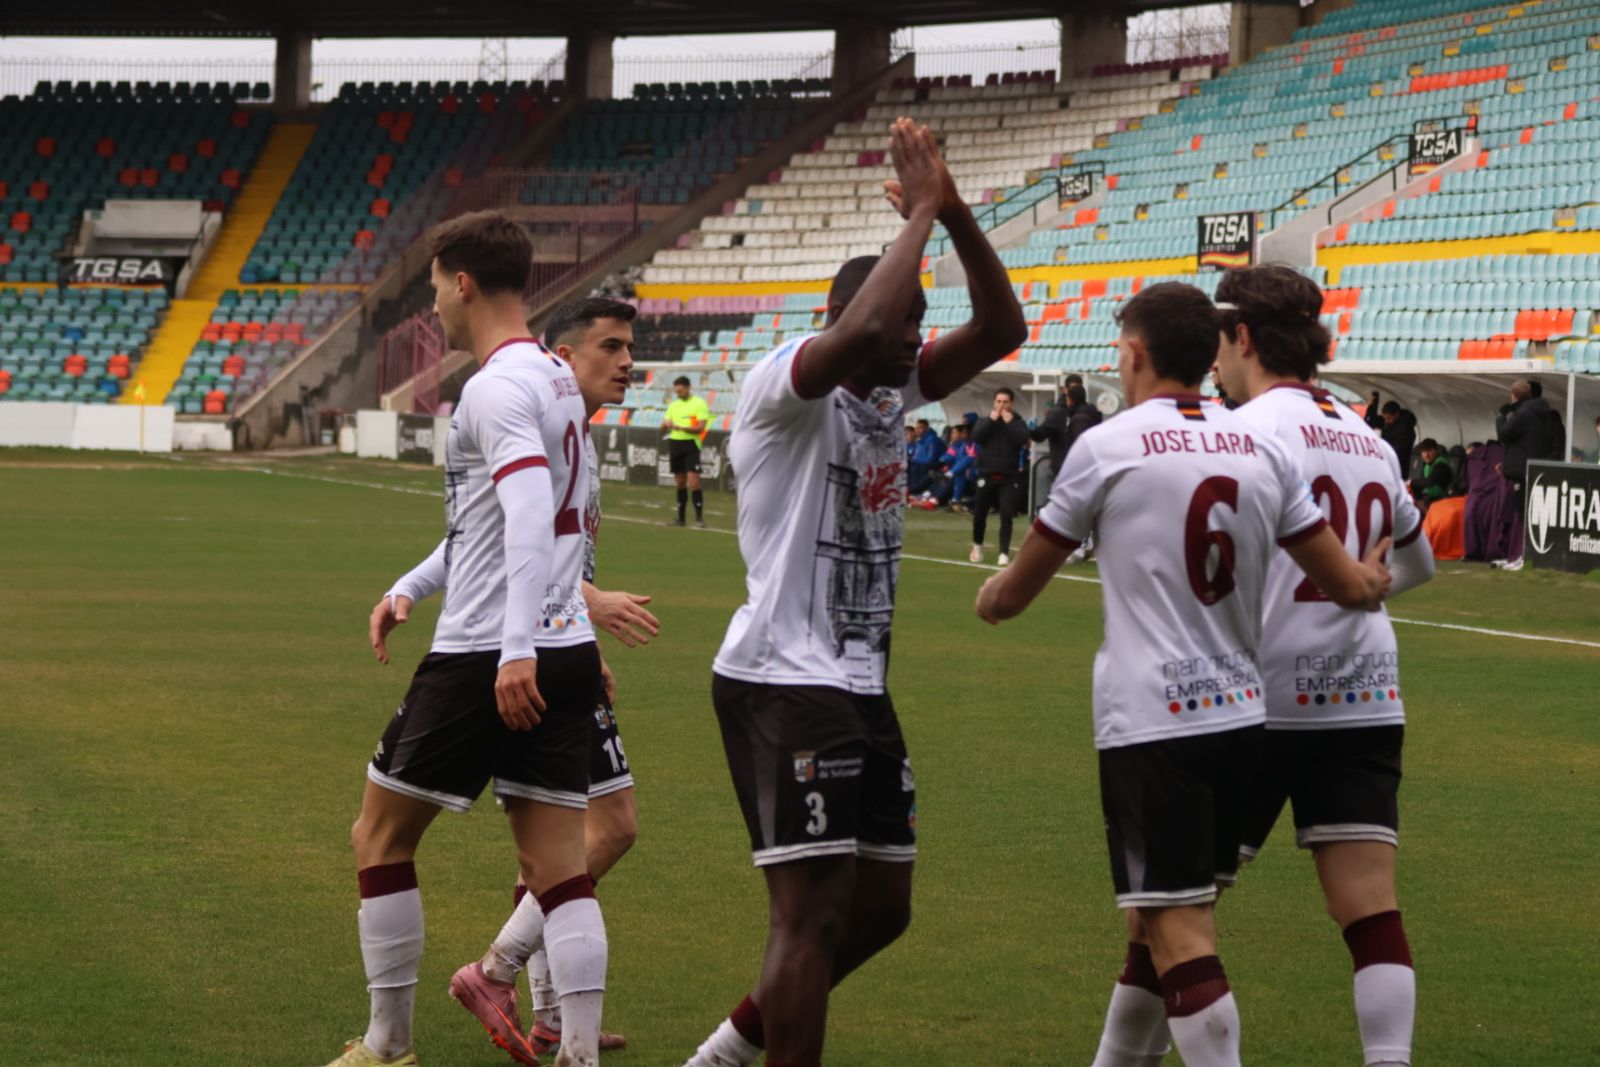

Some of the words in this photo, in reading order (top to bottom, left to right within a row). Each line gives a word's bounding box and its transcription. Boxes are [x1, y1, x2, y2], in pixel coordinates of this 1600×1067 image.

[1415, 131, 1457, 157] TGSA
[1204, 214, 1249, 244] TGSA
[75, 259, 163, 279] TGSA
[1141, 430, 1196, 456] JOSE
[1200, 431, 1258, 457] LARA
[1184, 475, 1239, 607] 6
[805, 791, 828, 836] 3
